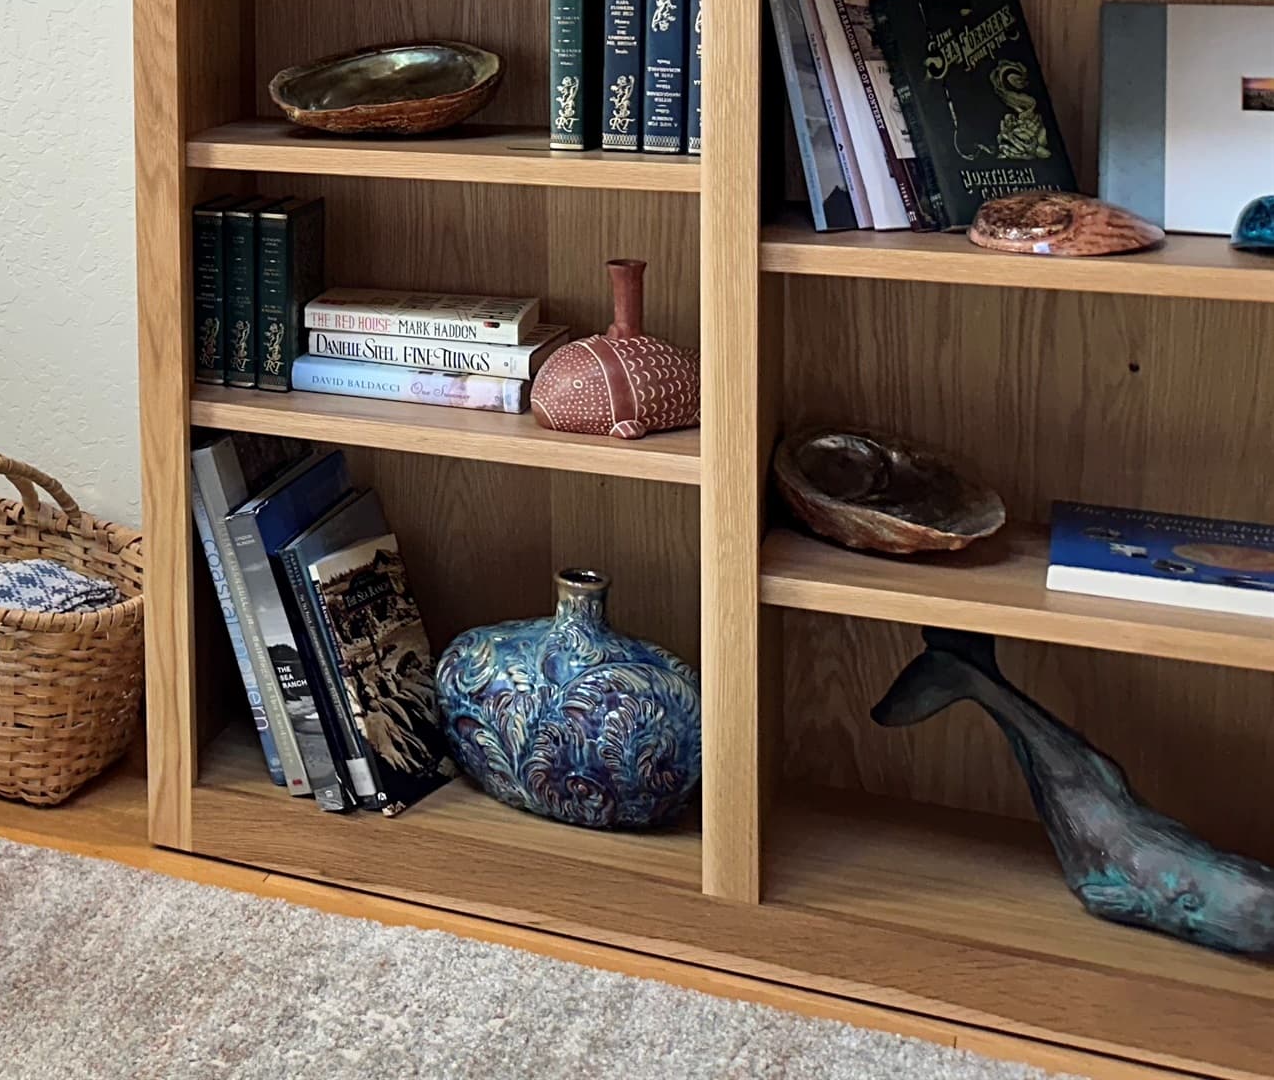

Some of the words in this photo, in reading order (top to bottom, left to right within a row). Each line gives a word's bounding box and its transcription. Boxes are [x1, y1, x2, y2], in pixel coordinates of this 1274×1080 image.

[841, 15, 857, 50] ABALONE
[854, 51, 865, 72] KING
[861, 73, 869, 84] OF
[866, 85, 885, 129] MONTEREY
[961, 168, 1036, 194] NORTHERN
[311, 311, 330, 328] THE
[334, 313, 356, 330] RED
[358, 315, 391, 333] HOUSE
[398, 319, 431, 336] MARK
[434, 322, 477, 339] HADDON
[316, 333, 363, 357] DANIELLE
[363, 338, 398, 361] STEEL
[403, 346, 434, 366] FINE
[433, 347, 490, 371] THINGS
[312, 375, 344, 387] DAVID
[347, 379, 401, 393] BALDACCI
[410, 381, 431, 396] One
[204, 539, 239, 624] coastal
[279, 673, 294, 681] SEA
[282, 680, 307, 688] RANCH
